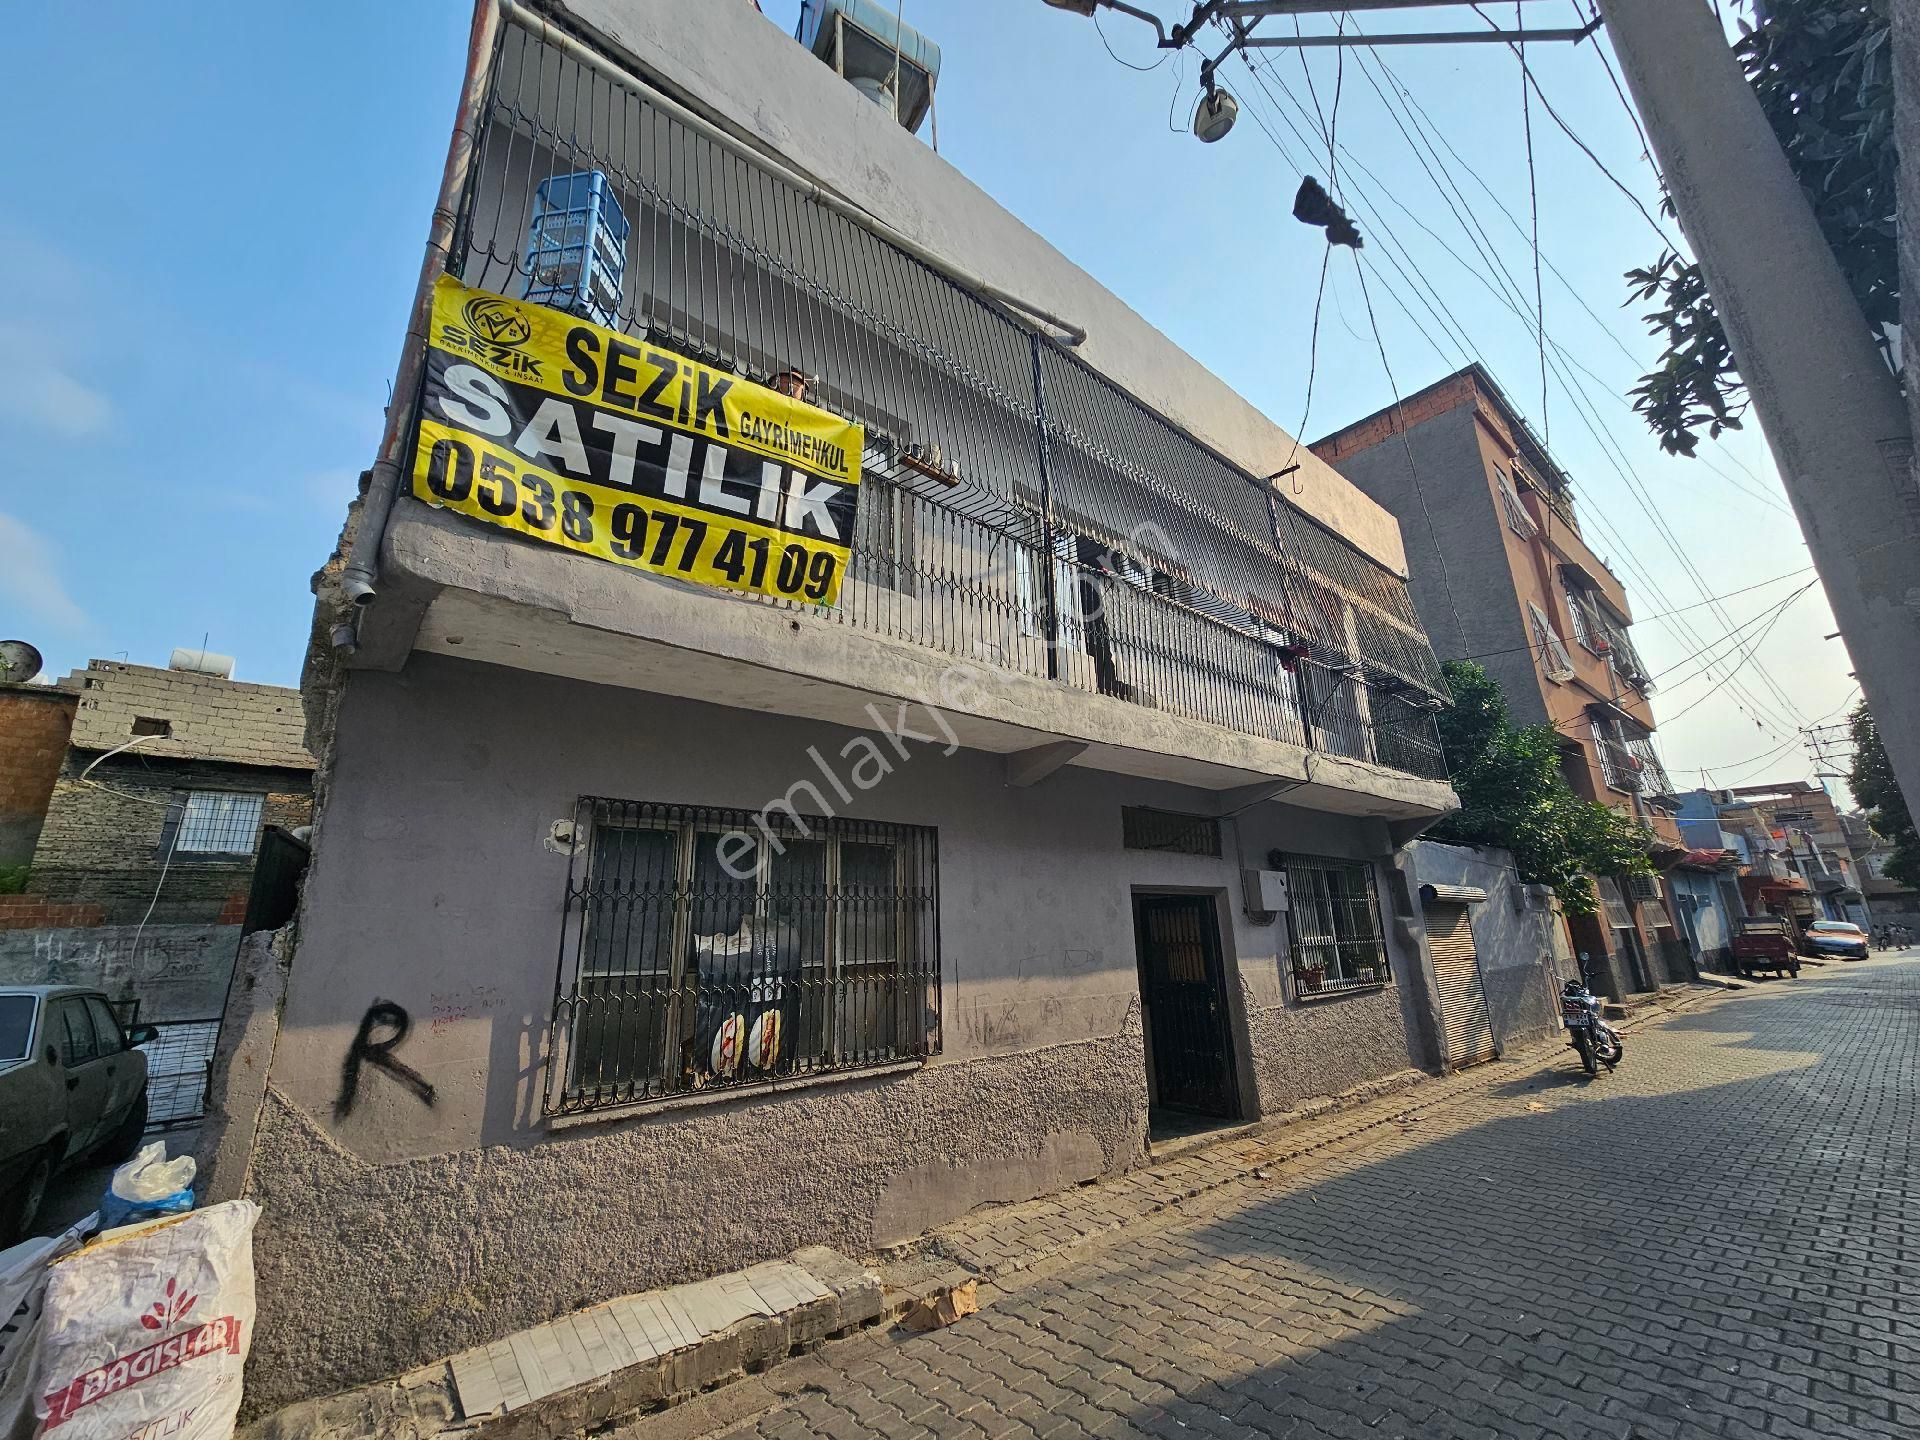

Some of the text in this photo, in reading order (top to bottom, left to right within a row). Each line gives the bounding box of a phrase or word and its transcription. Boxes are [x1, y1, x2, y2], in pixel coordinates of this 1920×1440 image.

[427, 439, 594, 543] 0538
[439, 365, 844, 541] SATILIK
[334, 998, 437, 1124] R
